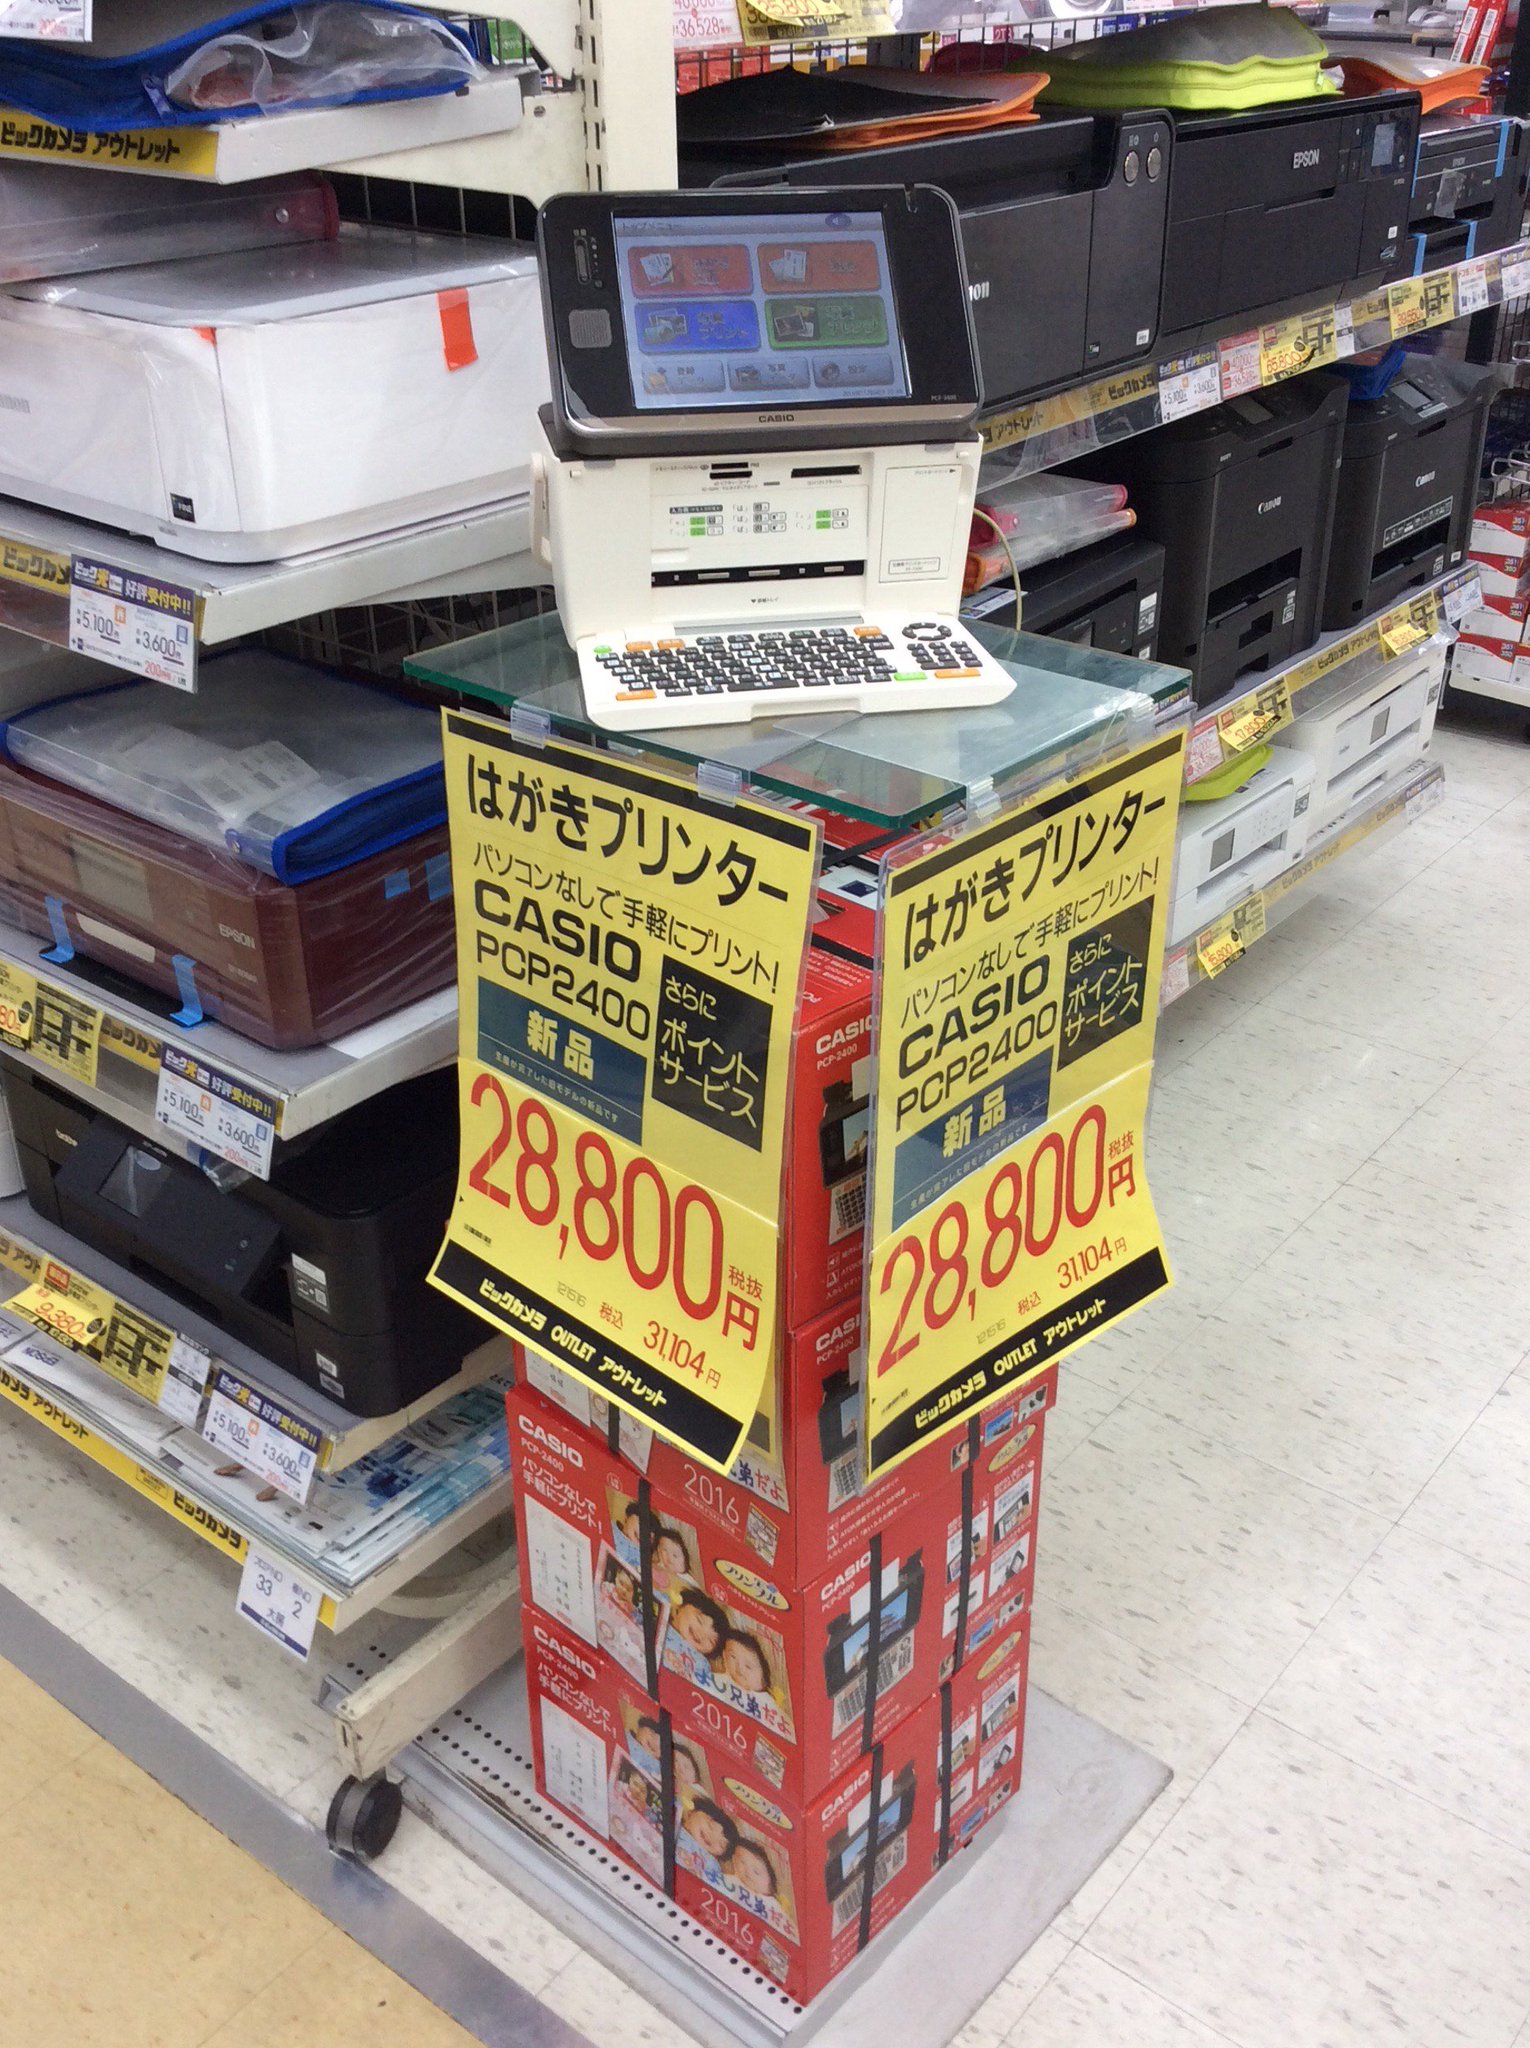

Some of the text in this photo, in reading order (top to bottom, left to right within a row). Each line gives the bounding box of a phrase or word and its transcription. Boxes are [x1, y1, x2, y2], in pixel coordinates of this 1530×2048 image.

[1293, 149, 1320, 169] EPSON
[1109, 371, 1155, 399] ビックカメラ
[758, 414, 795, 424] CASIO
[1257, 496, 1282, 515] Canon
[1415, 470, 1436, 488] Canon
[467, 753, 789, 907] はがきプリンター
[903, 789, 1167, 971] はがきプリンター
[218, 922, 257, 950] EPSON
[472, 841, 780, 994] パソコンなしで手軽にプリント!
[474, 878, 642, 983] CASIO
[900, 856, 1160, 1029] パソコンなしで手軽にプリント!
[1068, 932, 1112, 974] さらに
[476, 928, 651, 1042] PCP2400
[664, 975, 718, 1021] さらに
[898, 952, 1051, 1079] CASIO
[1064, 984, 1141, 1048] サービス
[1065, 959, 1143, 1017] ポイント
[526, 1009, 595, 1082] 新品
[659, 1017, 760, 1084] ポイント
[817, 1042, 858, 1071] PCP-2400
[895, 1000, 1059, 1133] PCP2400
[659, 1054, 758, 1129] サービス
[942, 1084, 1006, 1160] 新品
[1107, 1129, 1135, 1160] 税抜
[468, 1072, 725, 1322] 28,800
[1108, 1152, 1137, 1208] 円
[876, 1103, 1107, 1379] 28,800
[728, 1264, 764, 1302] 税抜
[1017, 1235, 1128, 1317] 税込 31,104 円
[479, 1277, 668, 1408] ビックカメラ OUTLET アウトレット
[599, 1301, 722, 1389] 税込 31,104 円
[721, 1290, 760, 1352] 円
[914, 1369, 988, 1430] ビックカメラ
[992, 1337, 1039, 1378] OUTLET
[1042, 1296, 1108, 1348] アウトレット
[32, 1394, 90, 1439] アウトレット
[518, 1414, 584, 1469] CASIO
[173, 1488, 243, 1550] ビックカメラ
[683, 1463, 740, 1525] 2016
[255, 1573, 303, 1619] 33 2
[820, 1550, 872, 1602] CASIO
[533, 1624, 597, 1681] CASIO
[691, 1690, 748, 1751] 2016
[821, 1769, 870, 1822] CASIO
[700, 1887, 755, 1946] 2016
